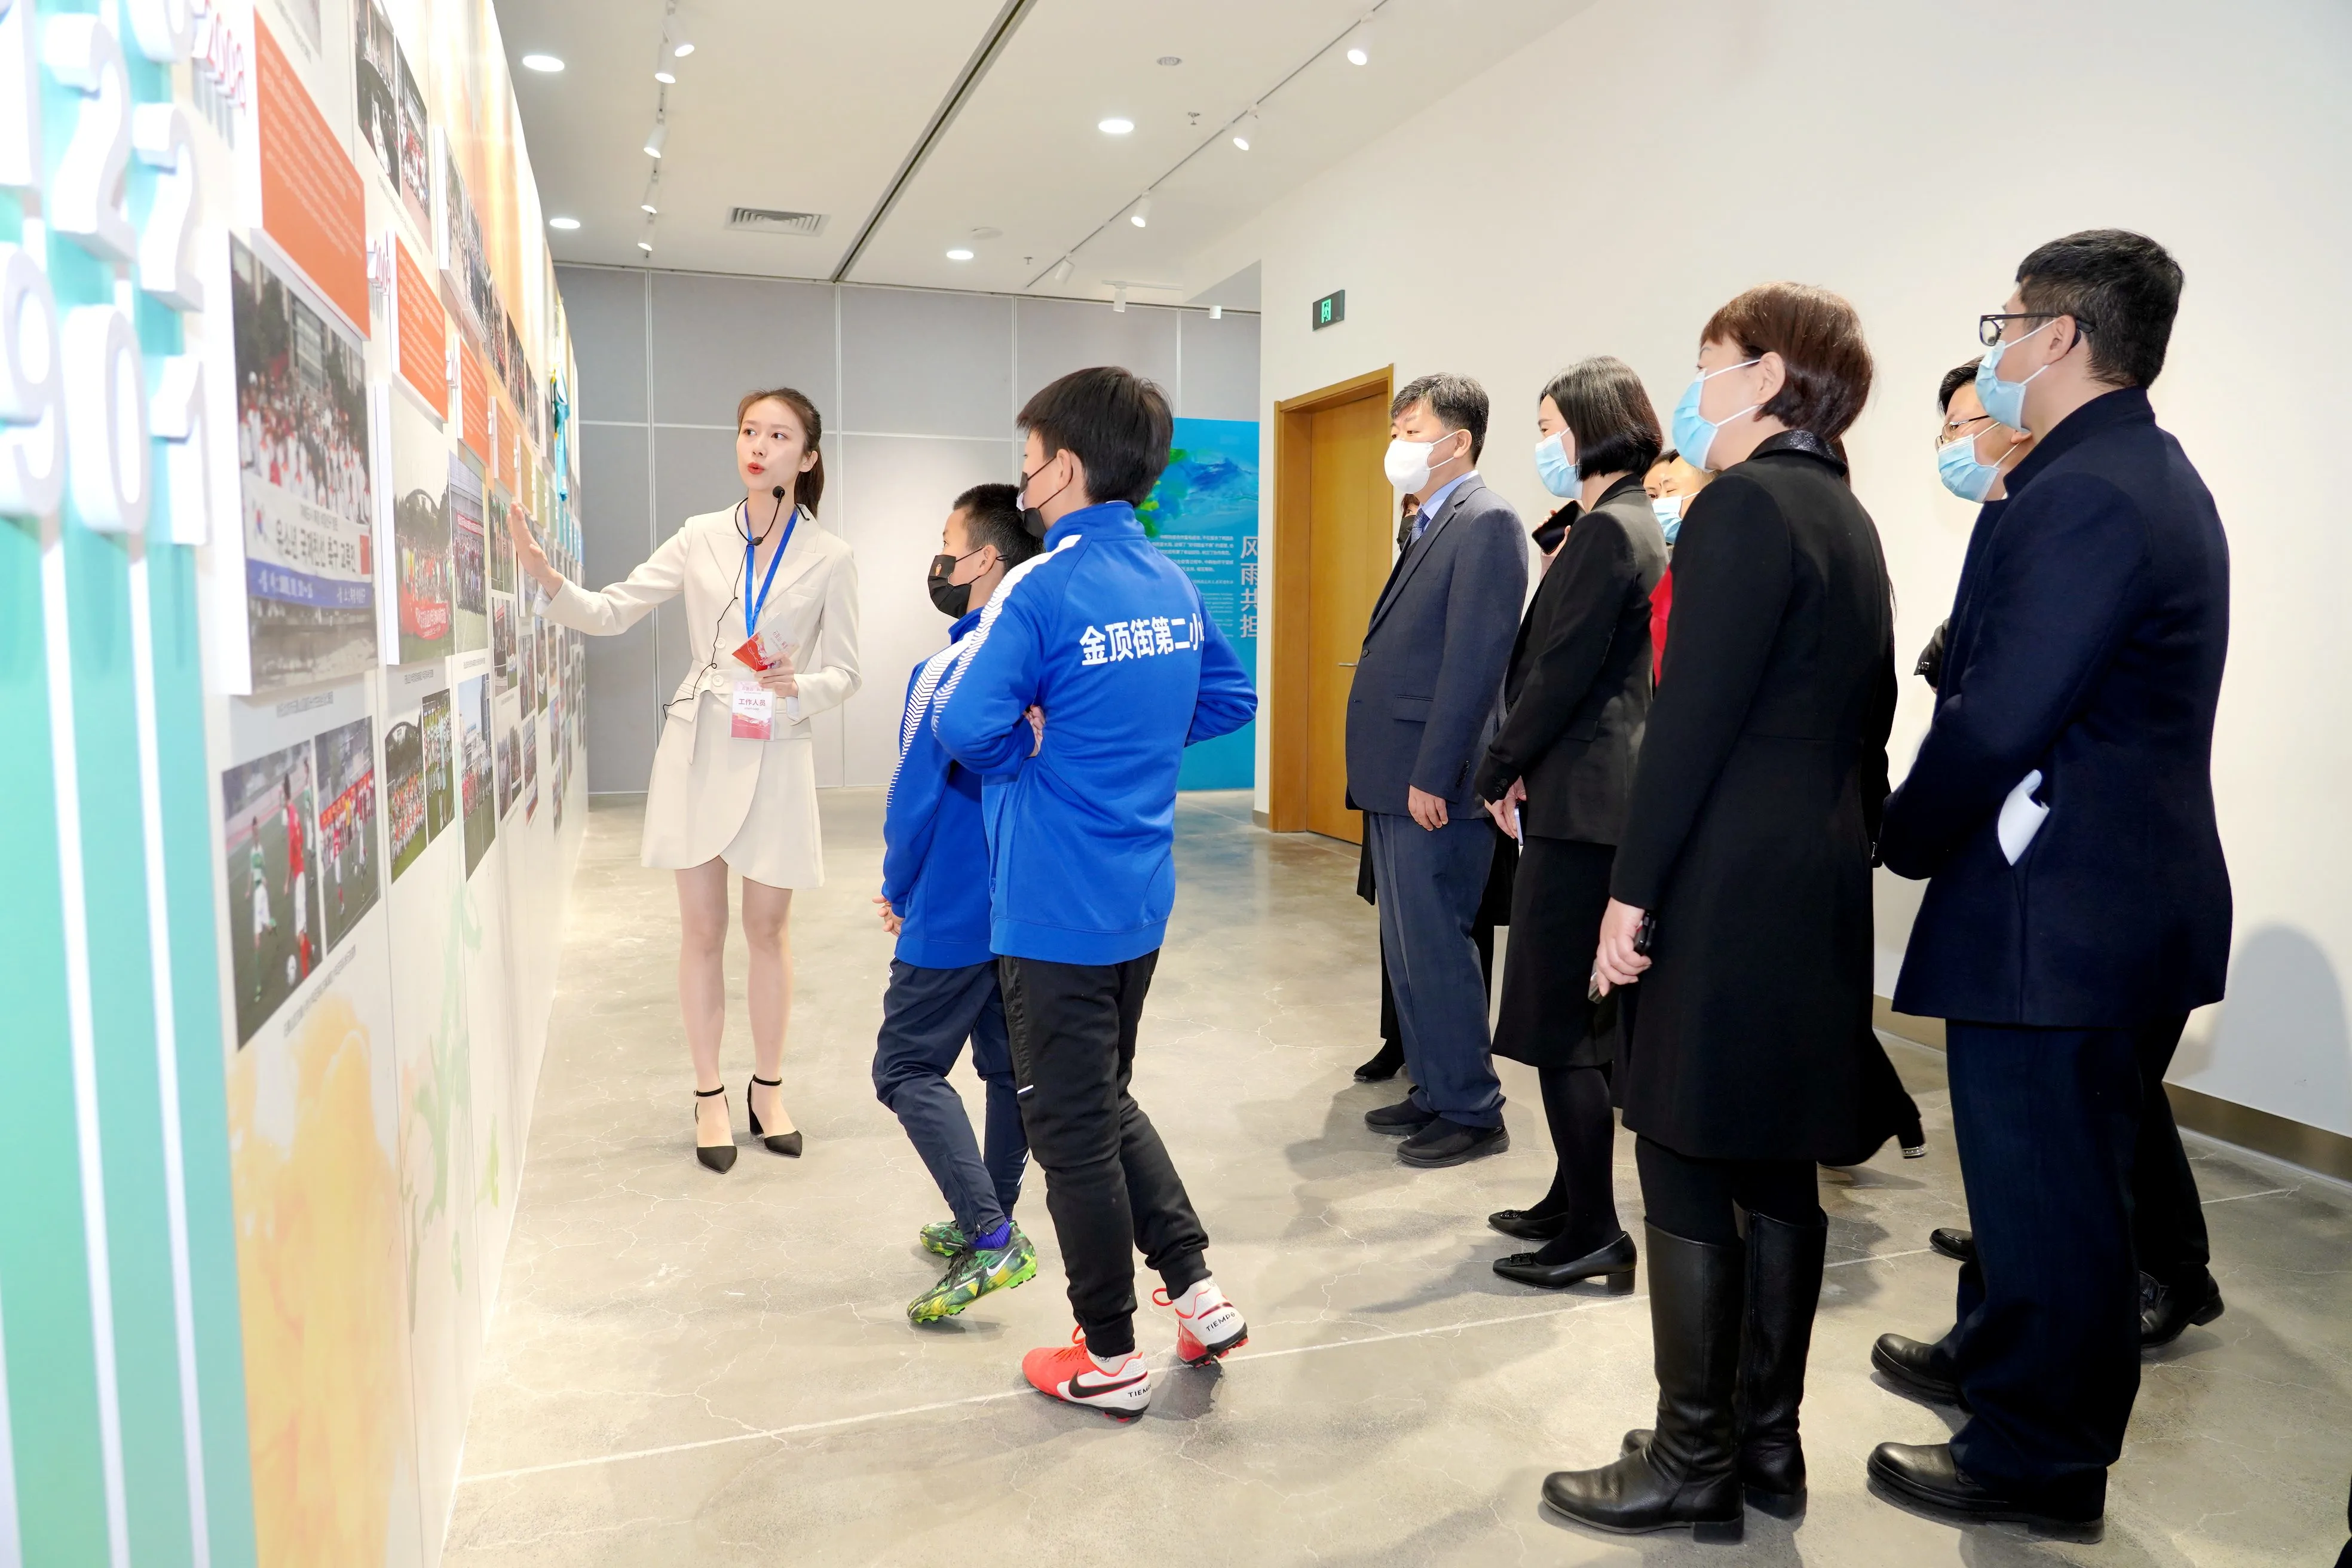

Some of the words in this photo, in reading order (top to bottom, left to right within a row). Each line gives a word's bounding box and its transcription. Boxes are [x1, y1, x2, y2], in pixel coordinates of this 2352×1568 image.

[1079, 613, 1205, 666] 金顶街第二小
[738, 698, 765, 707] 工作人员
